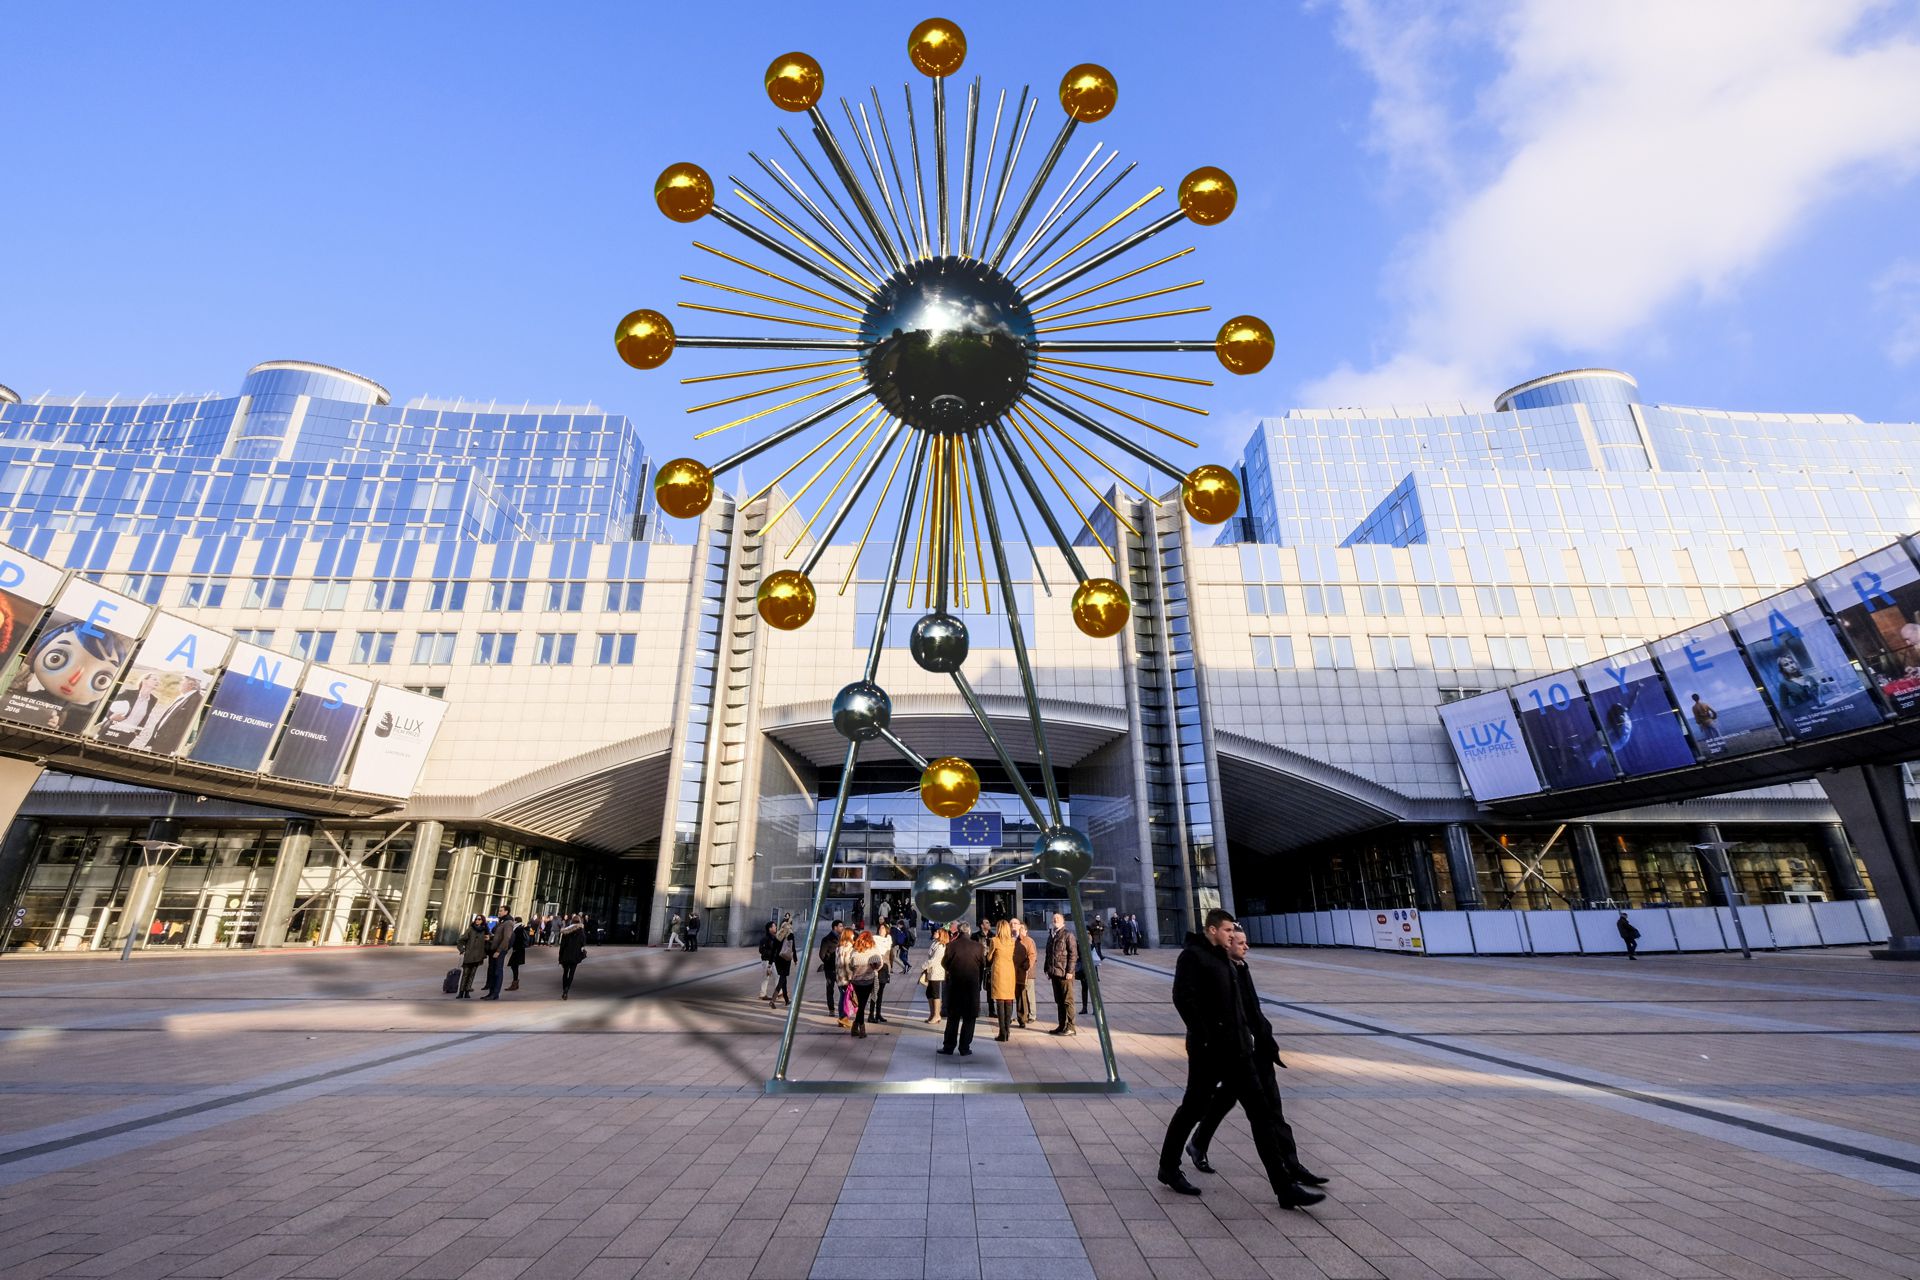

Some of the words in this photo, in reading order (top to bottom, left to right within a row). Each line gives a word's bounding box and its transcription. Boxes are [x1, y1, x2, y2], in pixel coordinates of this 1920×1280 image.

[80, 600, 119, 640] E
[165, 633, 198, 669] A
[246, 655, 282, 690] N
[322, 681, 348, 710] S
[1528, 683, 1572, 715] 10
[211, 709, 229, 718] AND
[229, 713, 243, 721] THE
[242, 716, 274, 729] JOURNEY
[394, 715, 424, 733] LUX
[1457, 720, 1513, 750] LUX
[1464, 747, 1487, 758] FILM
[1488, 740, 1517, 753] PRIZE
